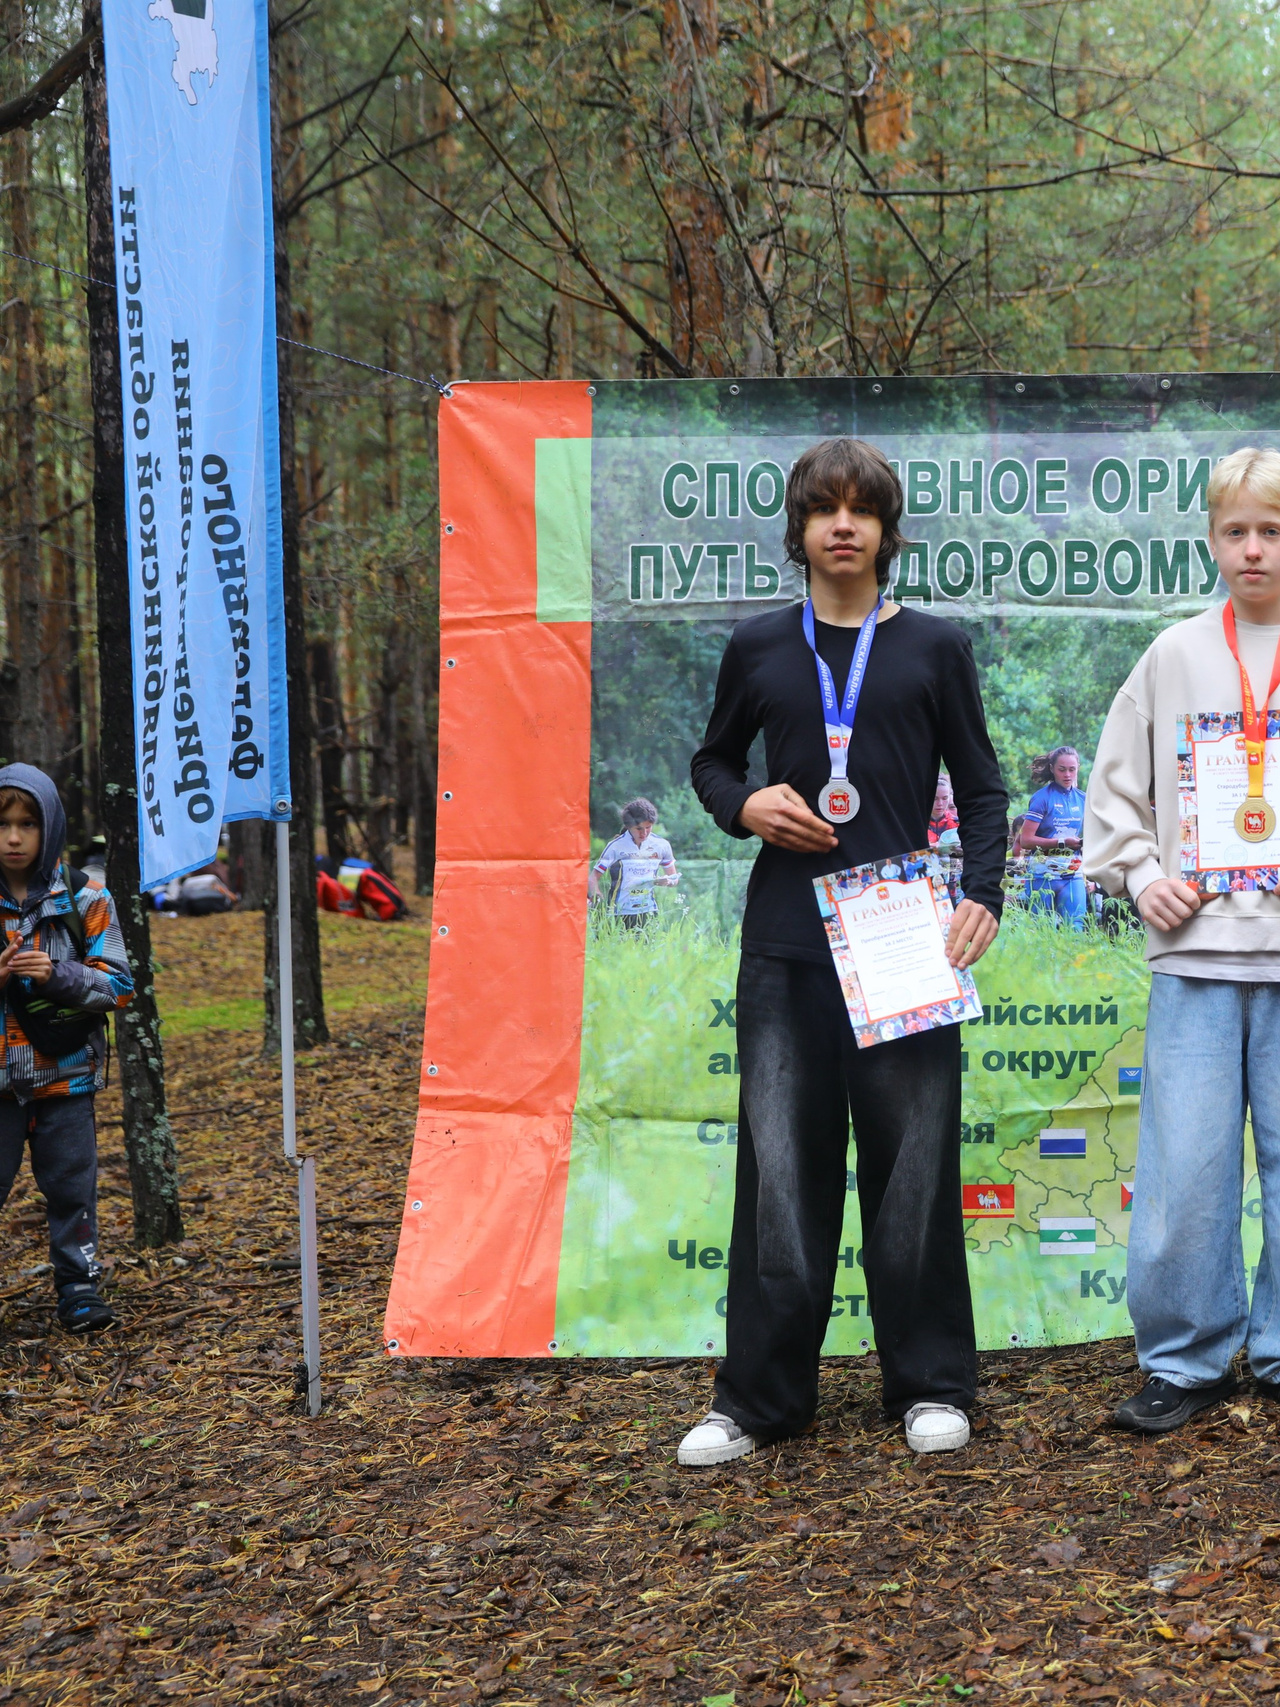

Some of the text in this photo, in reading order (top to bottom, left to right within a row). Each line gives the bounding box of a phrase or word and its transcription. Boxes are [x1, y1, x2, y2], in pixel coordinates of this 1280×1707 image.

[663, 459, 1067, 518] СПОВНОЕ
[630, 544, 780, 599] ПУТЬ
[893, 539, 1219, 606] ДОРОВОМУ
[846, 669, 861, 710] ОБЛАСТЬ
[1205, 752, 1278, 766] ГРАМА
[851, 896, 923, 922] ГРАМОТА
[982, 1050, 1097, 1080] округ
